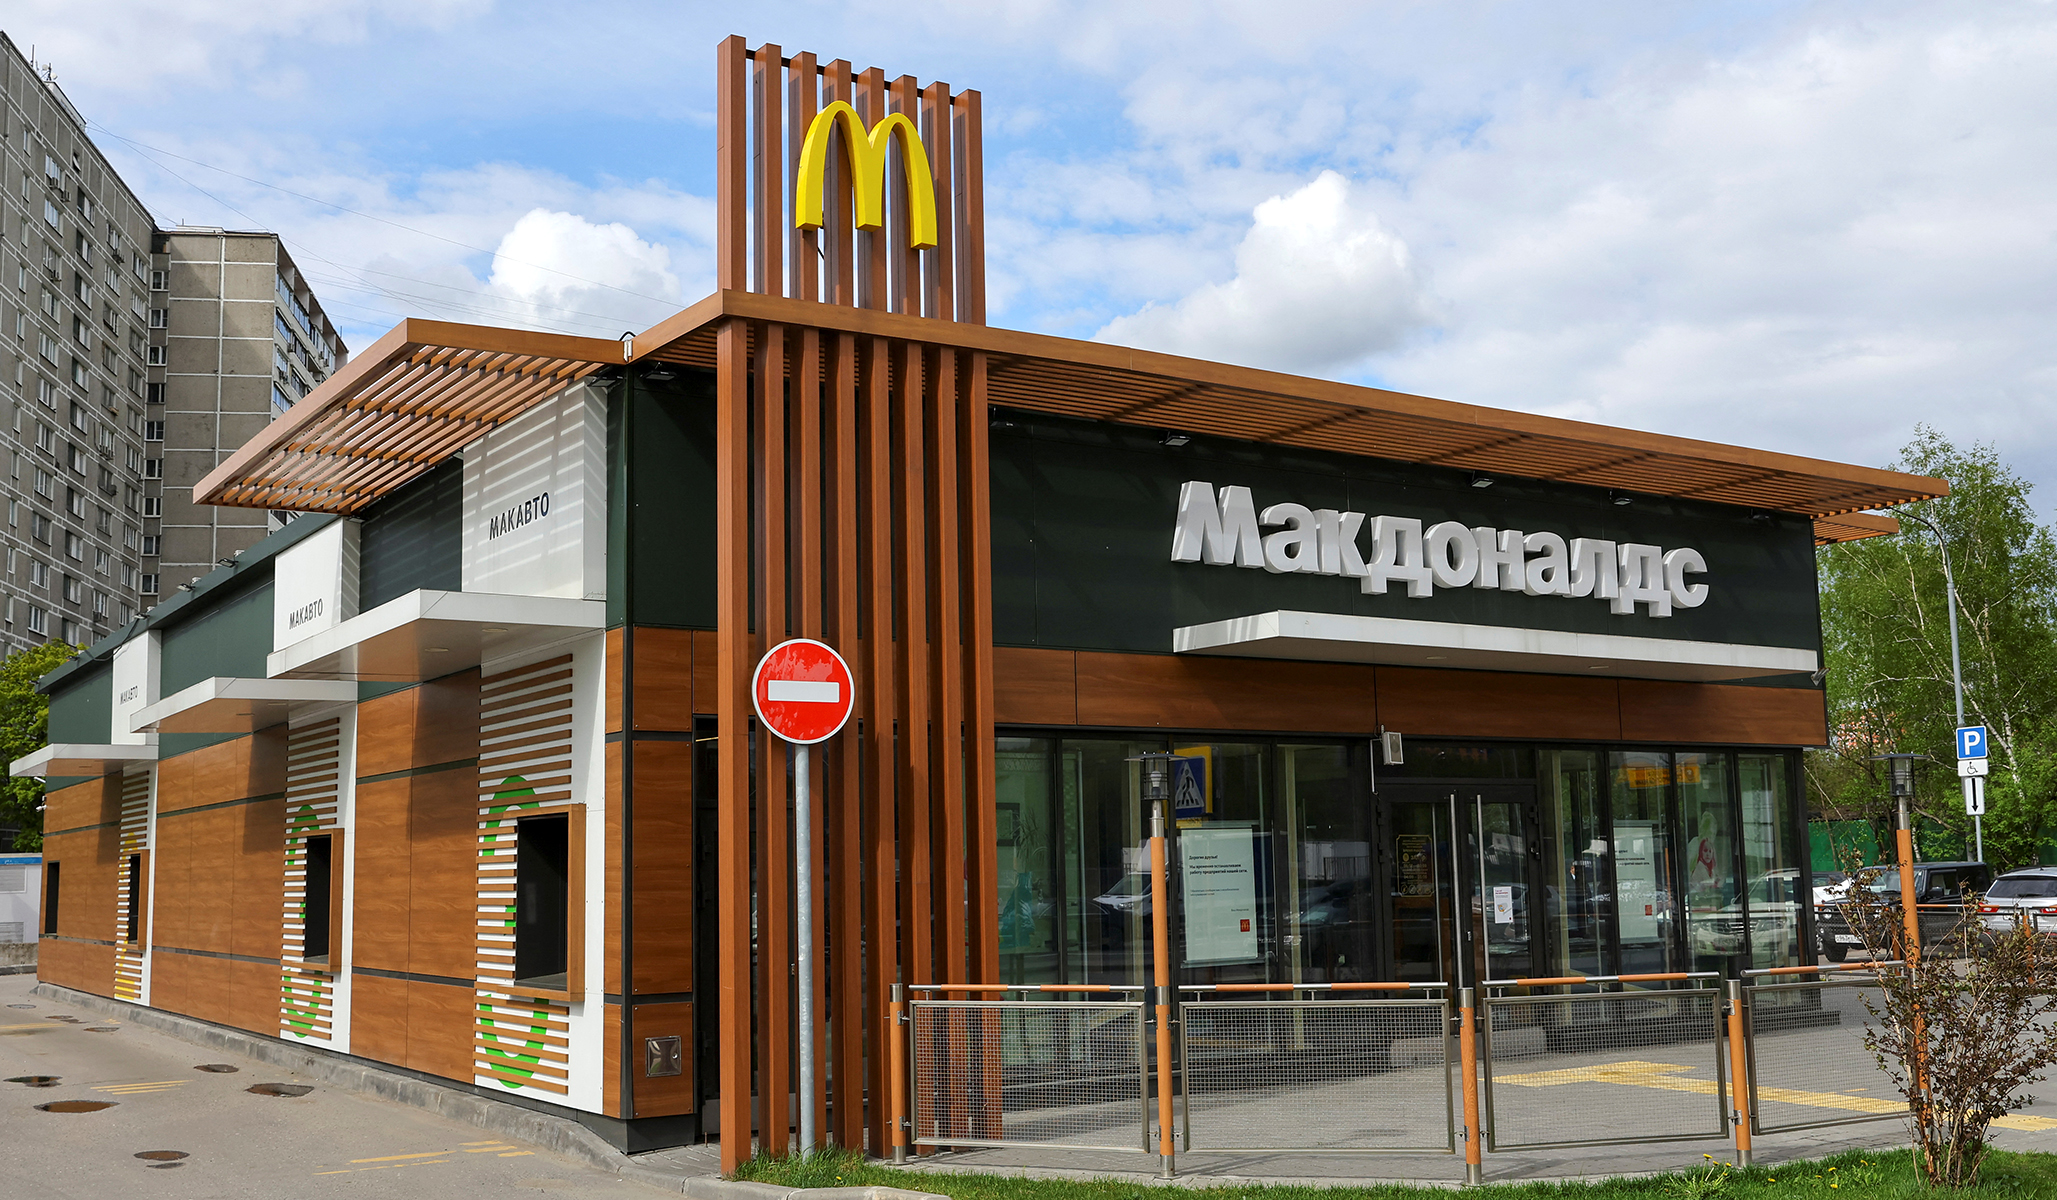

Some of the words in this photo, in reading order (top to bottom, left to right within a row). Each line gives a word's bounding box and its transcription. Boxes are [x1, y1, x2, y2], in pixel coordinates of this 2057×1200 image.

[489, 491, 550, 541] МАКАВТО
[1170, 480, 1709, 618] Макдоналдс
[289, 598, 323, 630] МАКАВТО
[1963, 730, 1981, 756] P
